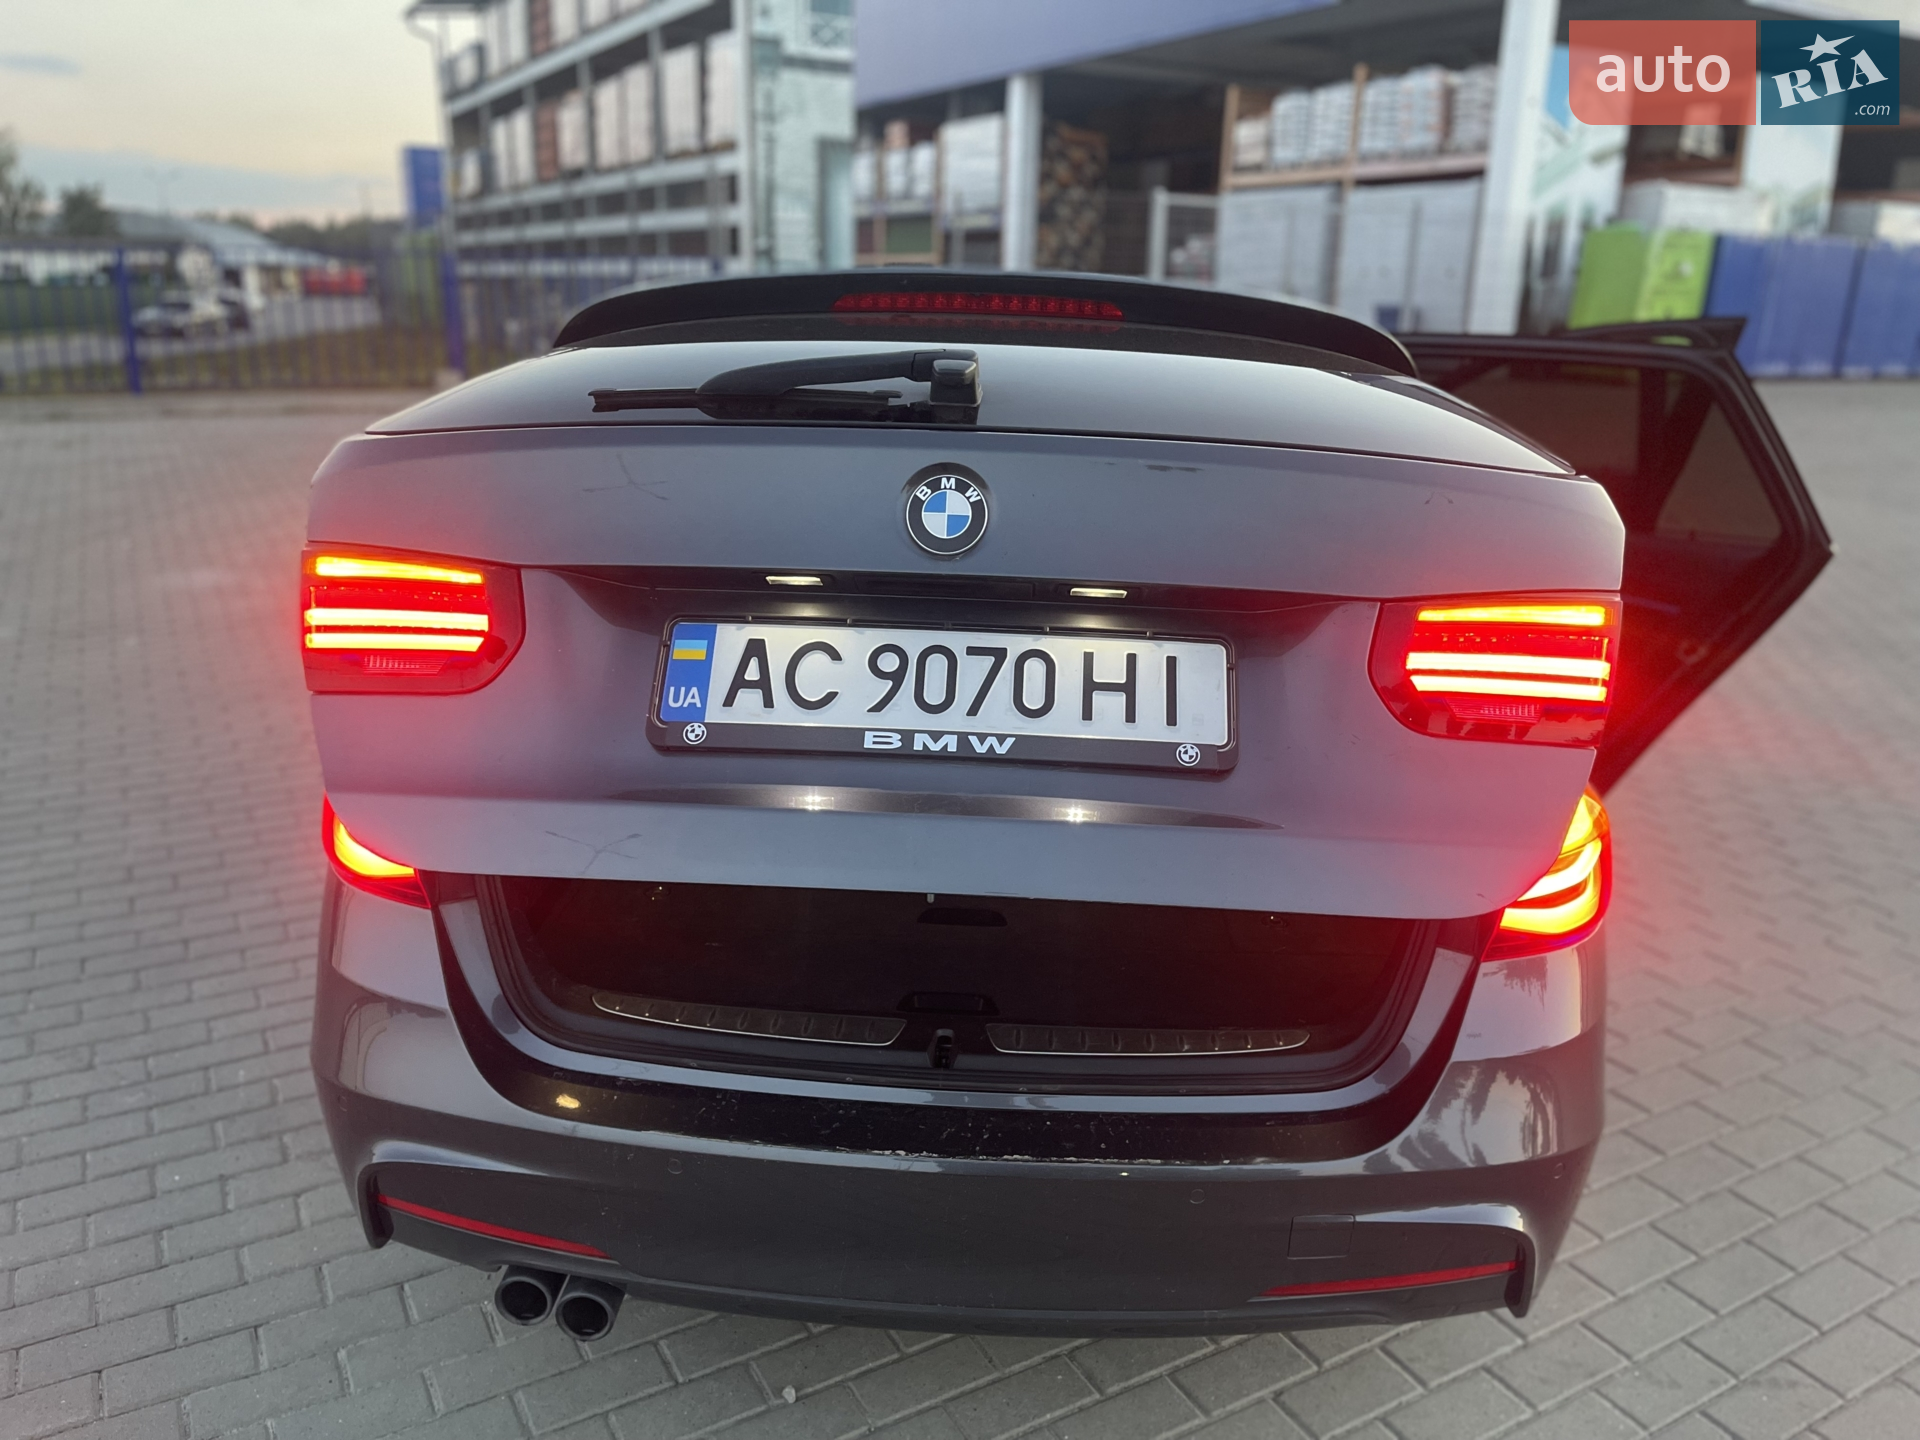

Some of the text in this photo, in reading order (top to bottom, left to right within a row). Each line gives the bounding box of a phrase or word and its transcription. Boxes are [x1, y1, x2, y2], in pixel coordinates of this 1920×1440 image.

[915, 477, 982, 503] BMW
[722, 638, 1178, 727] AC 9070 HI
[668, 686, 702, 708] UA
[863, 730, 1016, 755] BMW
